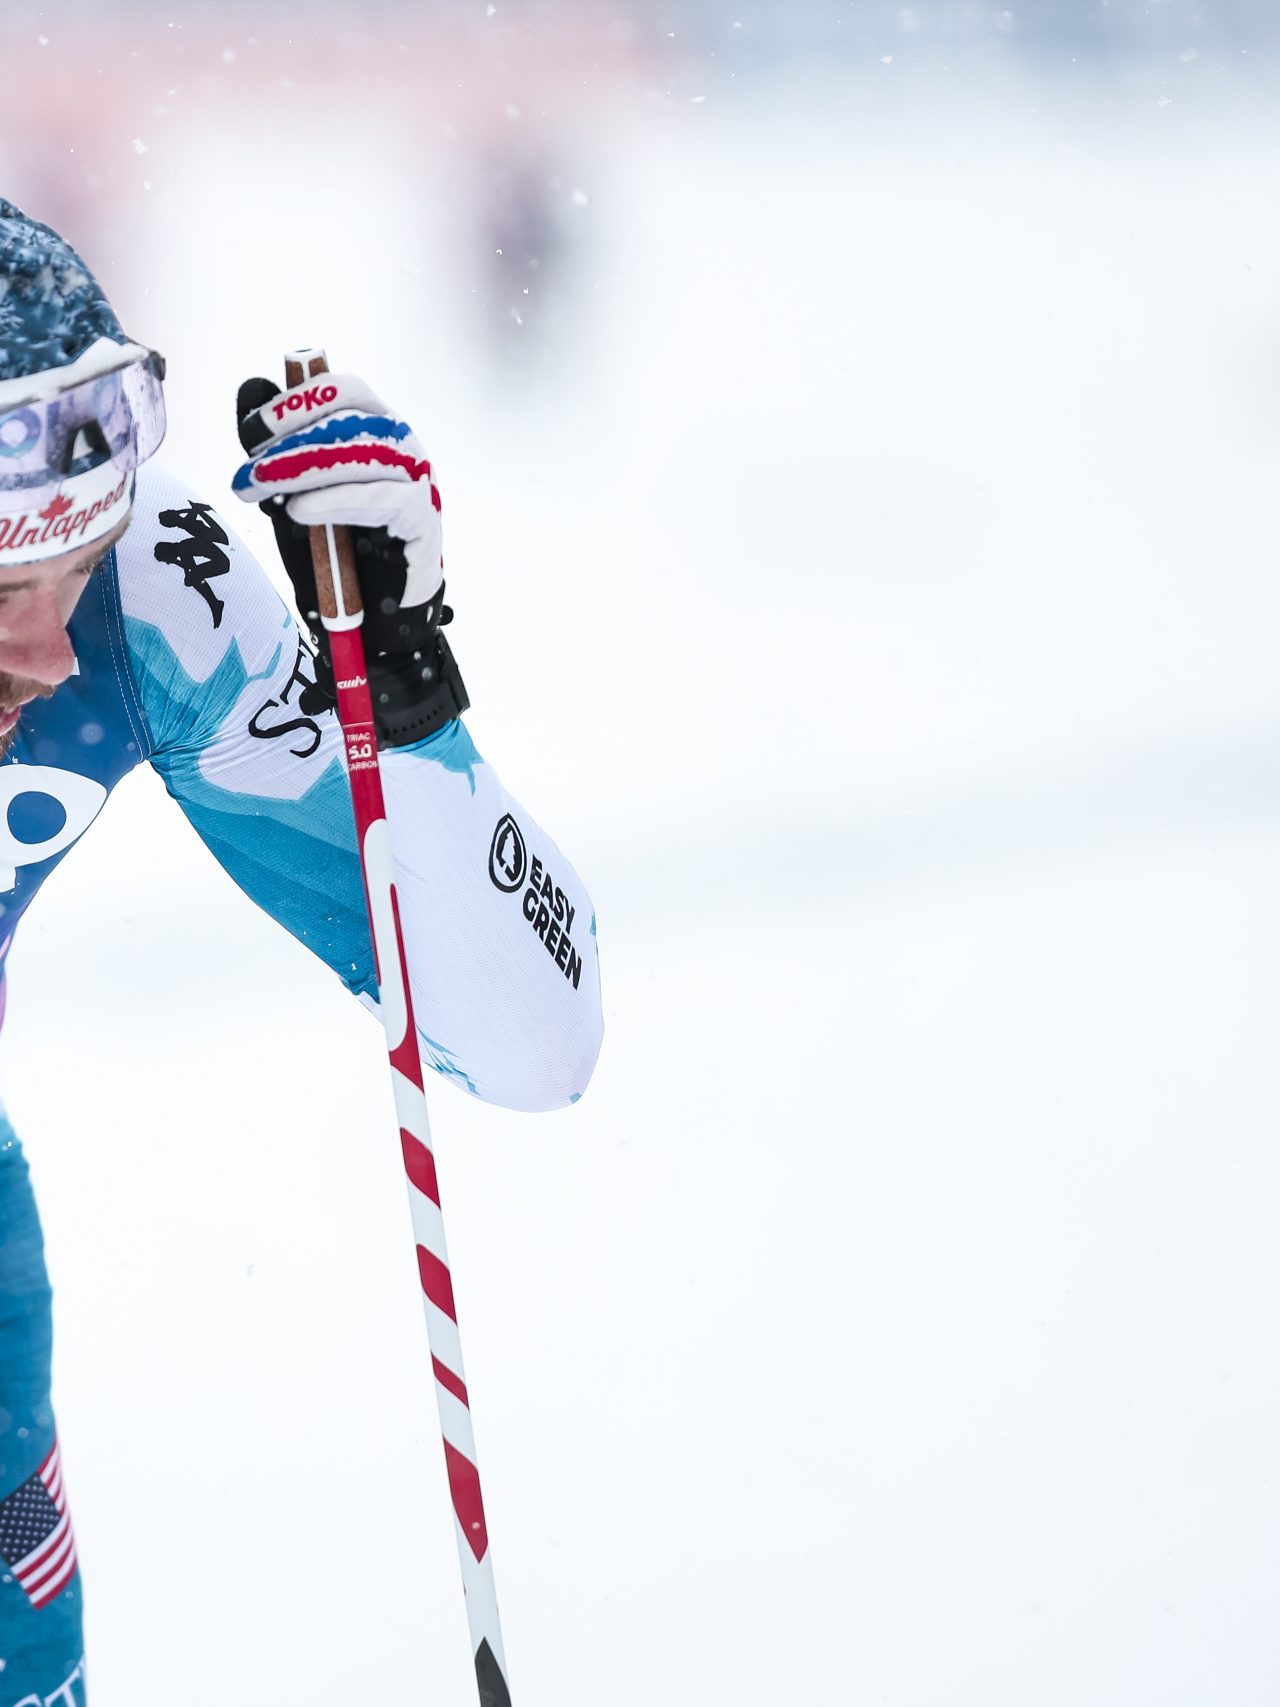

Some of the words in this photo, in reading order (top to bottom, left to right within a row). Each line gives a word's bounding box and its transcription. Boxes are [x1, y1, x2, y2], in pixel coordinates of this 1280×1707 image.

[272, 385, 337, 420] TOKO
[530, 854, 575, 934] EASY
[523, 888, 582, 991] GREEN
